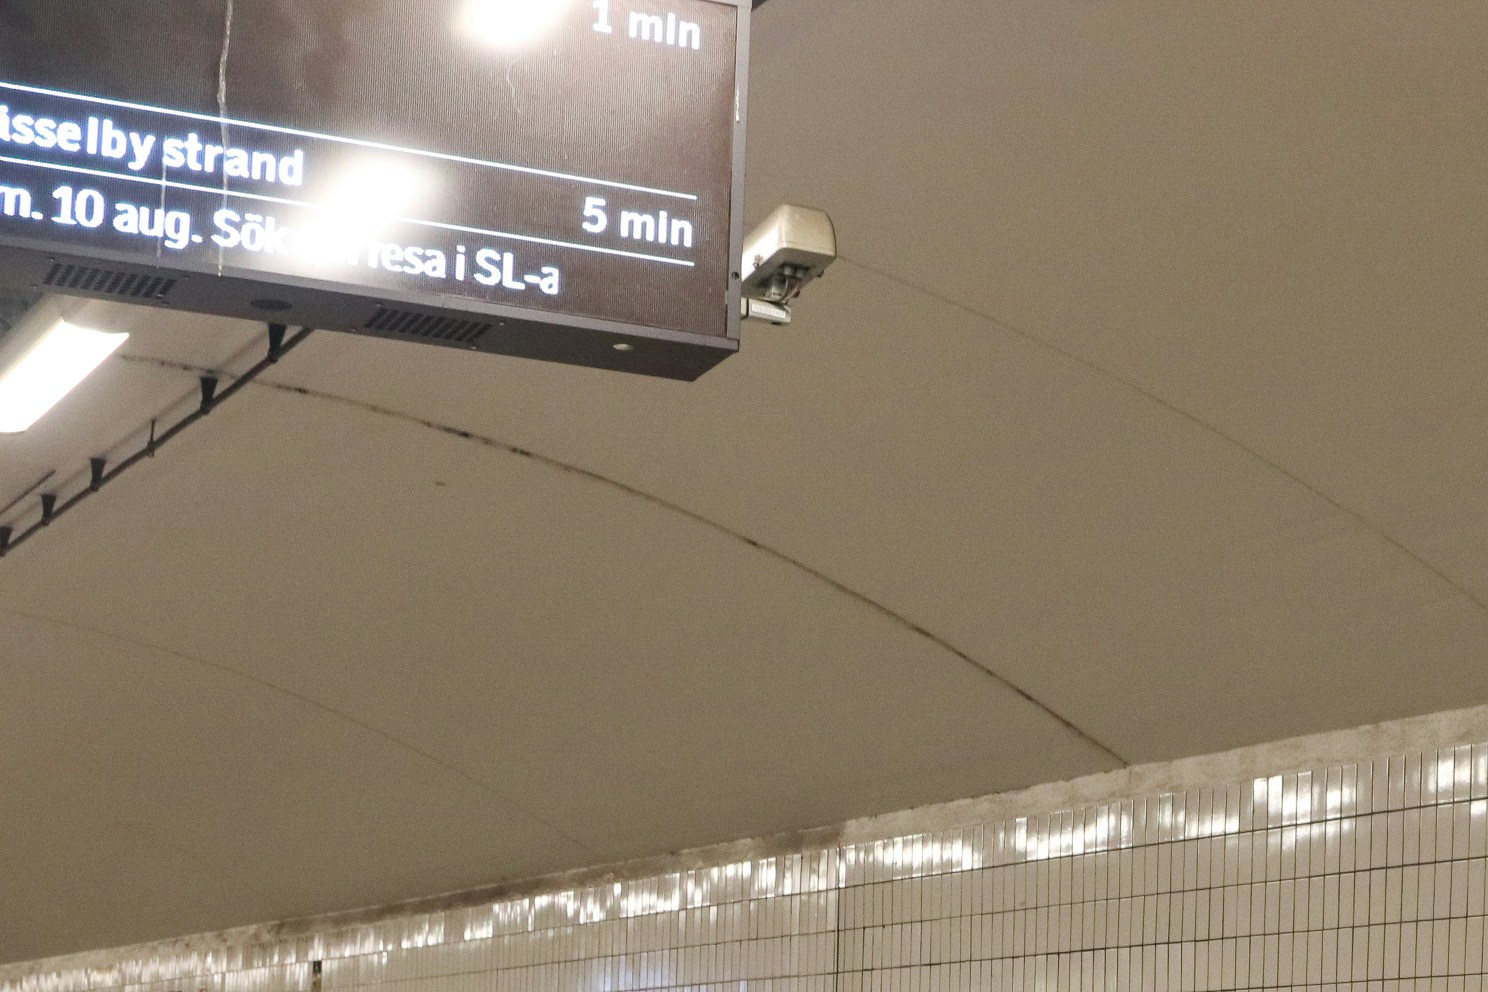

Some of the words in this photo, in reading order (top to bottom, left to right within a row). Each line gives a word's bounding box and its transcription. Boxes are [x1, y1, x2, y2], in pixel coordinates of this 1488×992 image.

[592, 0, 612, 33] 1
[628, 11, 700, 50] min
[163, 133, 304, 186] strand
[52, 186, 105, 228] 10
[112, 203, 203, 249] aug.
[455, 245, 466, 282] i
[474, 248, 560, 296] SL-a
[582, 196, 608, 233] 5
[620, 210, 693, 248] min
